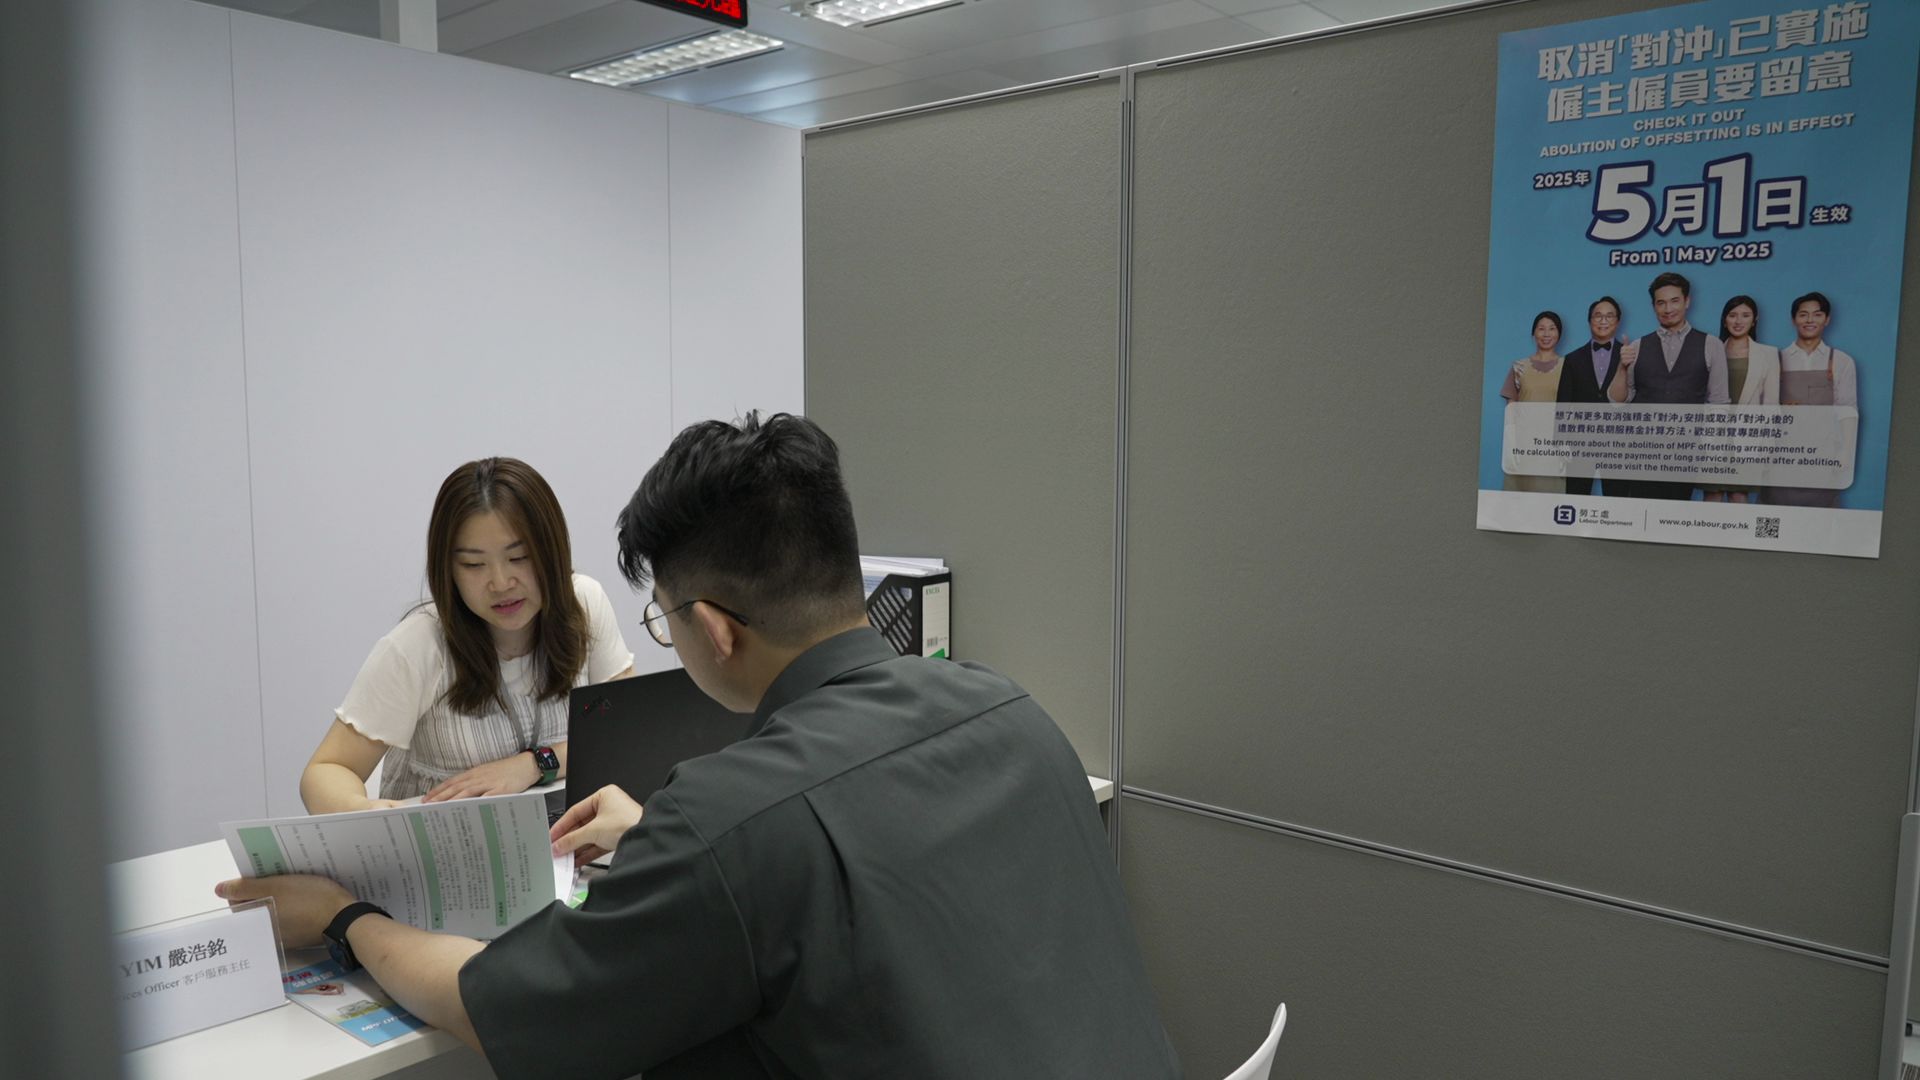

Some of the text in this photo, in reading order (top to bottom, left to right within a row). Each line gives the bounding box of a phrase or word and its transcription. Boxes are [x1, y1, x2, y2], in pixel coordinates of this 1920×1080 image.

[1538, 2, 1870, 82] 取消「對沖」已實施
[1547, 51, 1852, 122] 僱主僱員要留意
[1633, 109, 1745, 131] CHECK IT OUT
[1540, 113, 1855, 158] ABOLITION OF OFFSETTING IS IN EFFECT
[1534, 157, 1849, 241] 2025年 5月1日 生效
[1611, 243, 1770, 265] From 1 May 2025
[1533, 438, 1542, 446] To
[1543, 438, 1564, 446] learn
[1588, 439, 1610, 448] about
[1612, 440, 1626, 448] the
[1627, 441, 1665, 450] abolition
[1666, 442, 1676, 450] of
[1677, 442, 1696, 450] MPF
[1698, 443, 1742, 453] offsetting
[1744, 445, 1805, 455] arrangement
[1512, 448, 1842, 468] the calculation of severance payment or long service payment after abolition,
[1595, 462, 1623, 470] please
[1625, 462, 1642, 470] visit
[1660, 464, 1699, 473] thematic
[1701, 466, 1739, 475] website.
[1599, 519, 1633, 527] Department
[1659, 518, 1749, 530] www.op.labour.gov.hk
[120, 937, 228, 978] YIM 嚴浩銘
[144, 980, 181, 995] Officer
